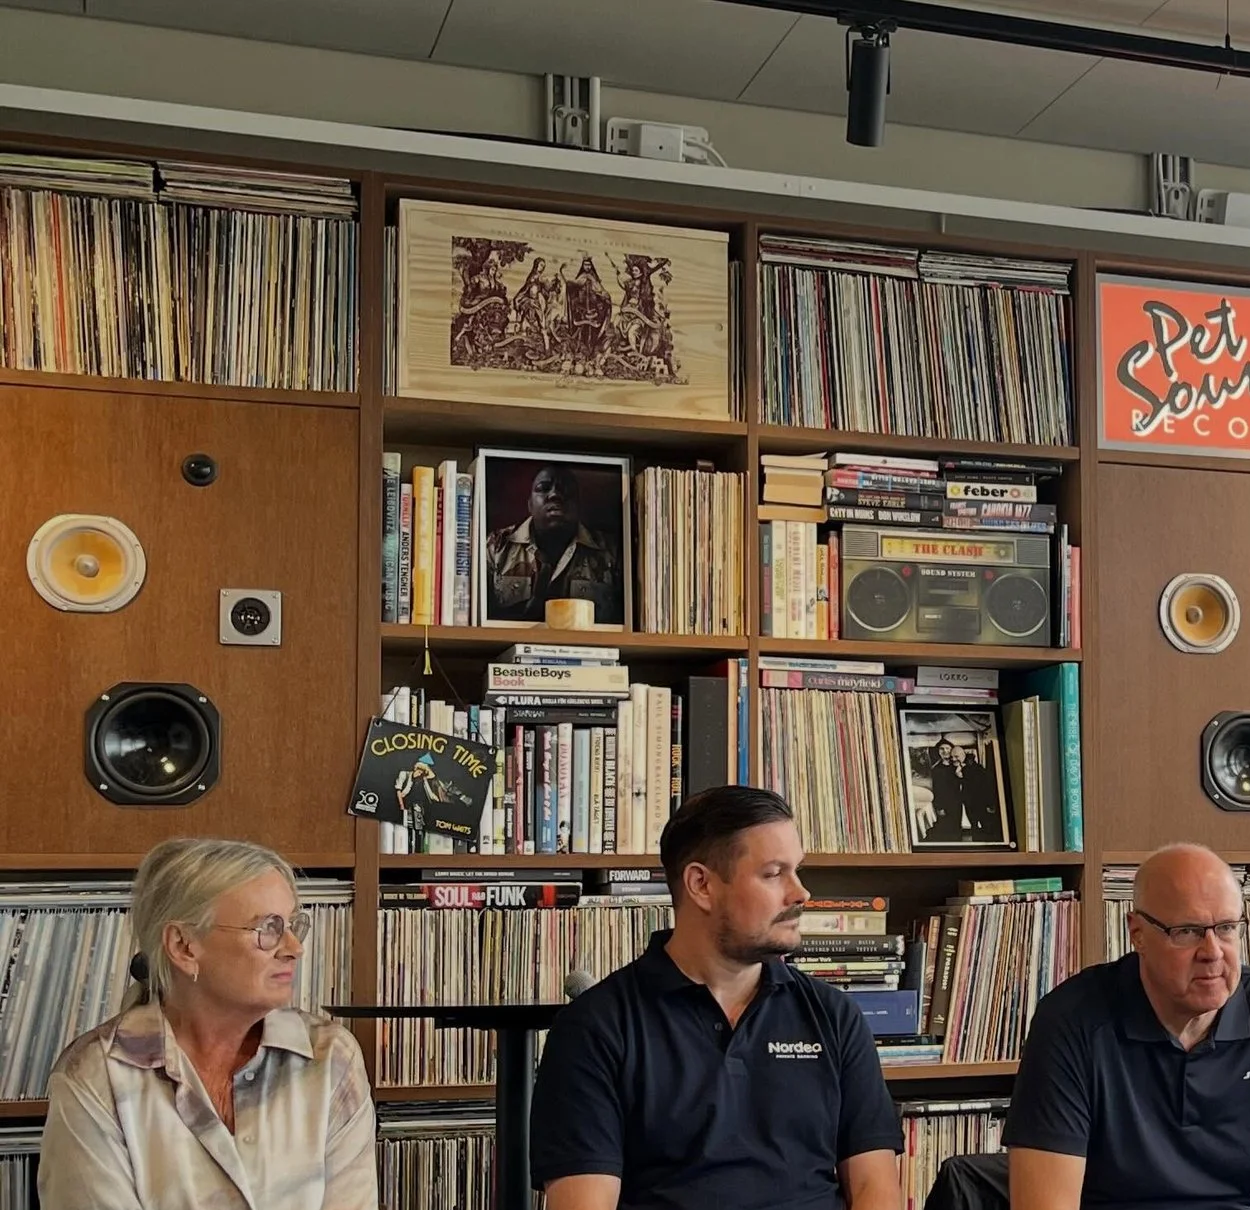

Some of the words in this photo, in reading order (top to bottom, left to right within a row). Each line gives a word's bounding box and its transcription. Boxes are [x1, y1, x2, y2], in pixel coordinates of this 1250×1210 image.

[1143, 297, 1247, 382] Pet
[963, 485, 1008, 498] feber
[386, 486, 396, 531] LEIBOVITZ
[401, 531, 410, 561] ANDERS
[912, 543, 939, 556] THE
[941, 543, 984, 557] CLASH
[456, 542, 470, 576] MUSIC
[400, 562, 409, 597] TENGNER
[920, 568, 945, 577] SOUND
[947, 569, 976, 578] SYSTEM
[492, 677, 525, 687] Book
[808, 676, 836, 687] curtis
[836, 676, 882, 690] mayfield
[938, 672, 969, 682] LOKKO
[508, 696, 541, 706] PLURA
[371, 733, 447, 756] CLOSING
[451, 745, 487, 778] TIME
[435, 820, 451, 830] TOM
[451, 822, 471, 834] WAITS
[609, 869, 650, 881] FORWARD
[435, 885, 473, 907] SOUL
[486, 886, 526, 907] FUNK
[768, 1041, 822, 1053] Nordea
